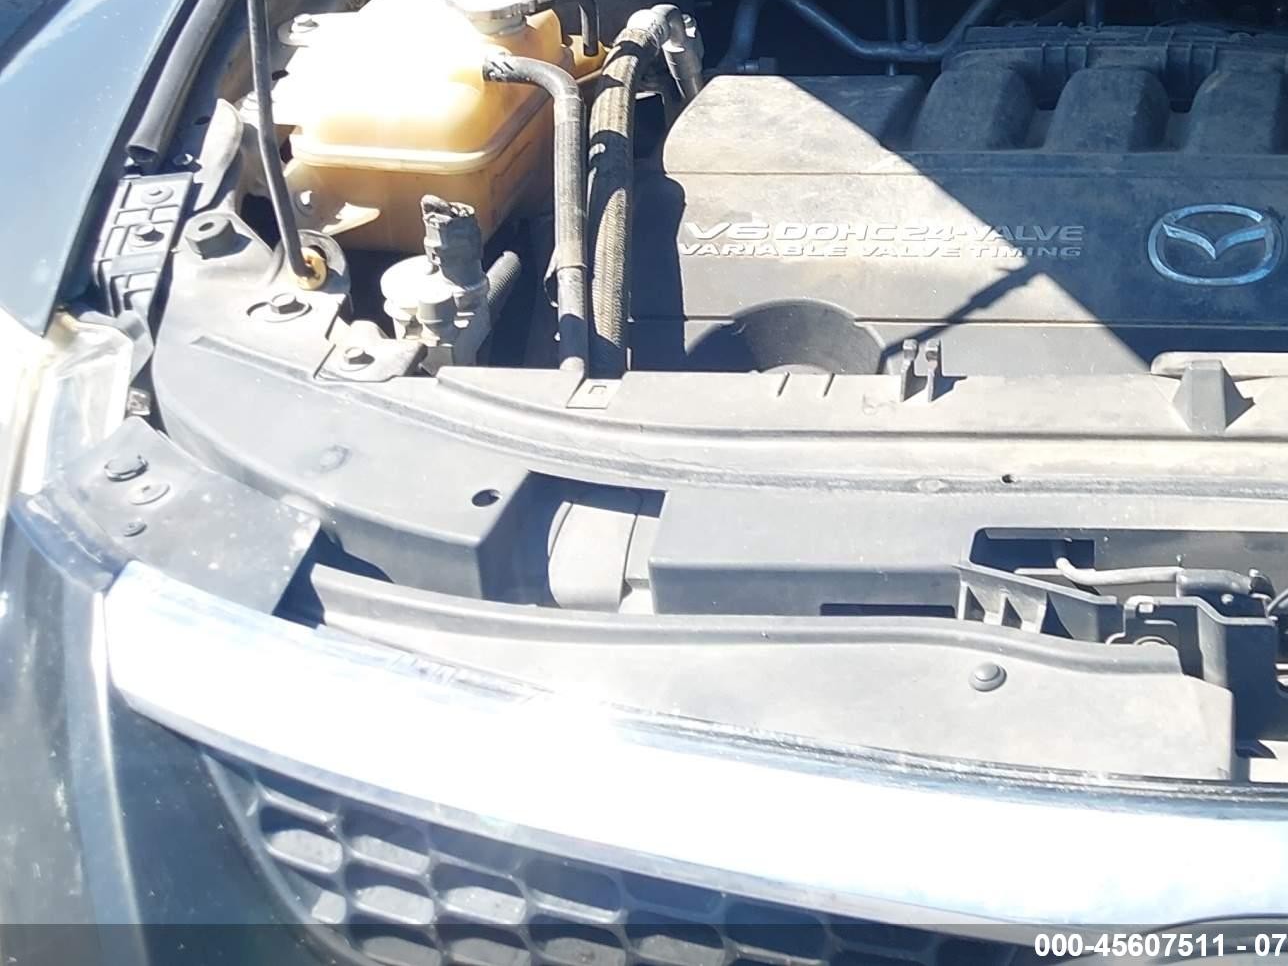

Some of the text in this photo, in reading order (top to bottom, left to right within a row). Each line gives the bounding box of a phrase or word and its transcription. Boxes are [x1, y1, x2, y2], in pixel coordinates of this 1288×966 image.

[684, 221, 1085, 242] V6 DOHC 24-VALVE
[679, 242, 1081, 258] VARIABLE VALVE TIMING
